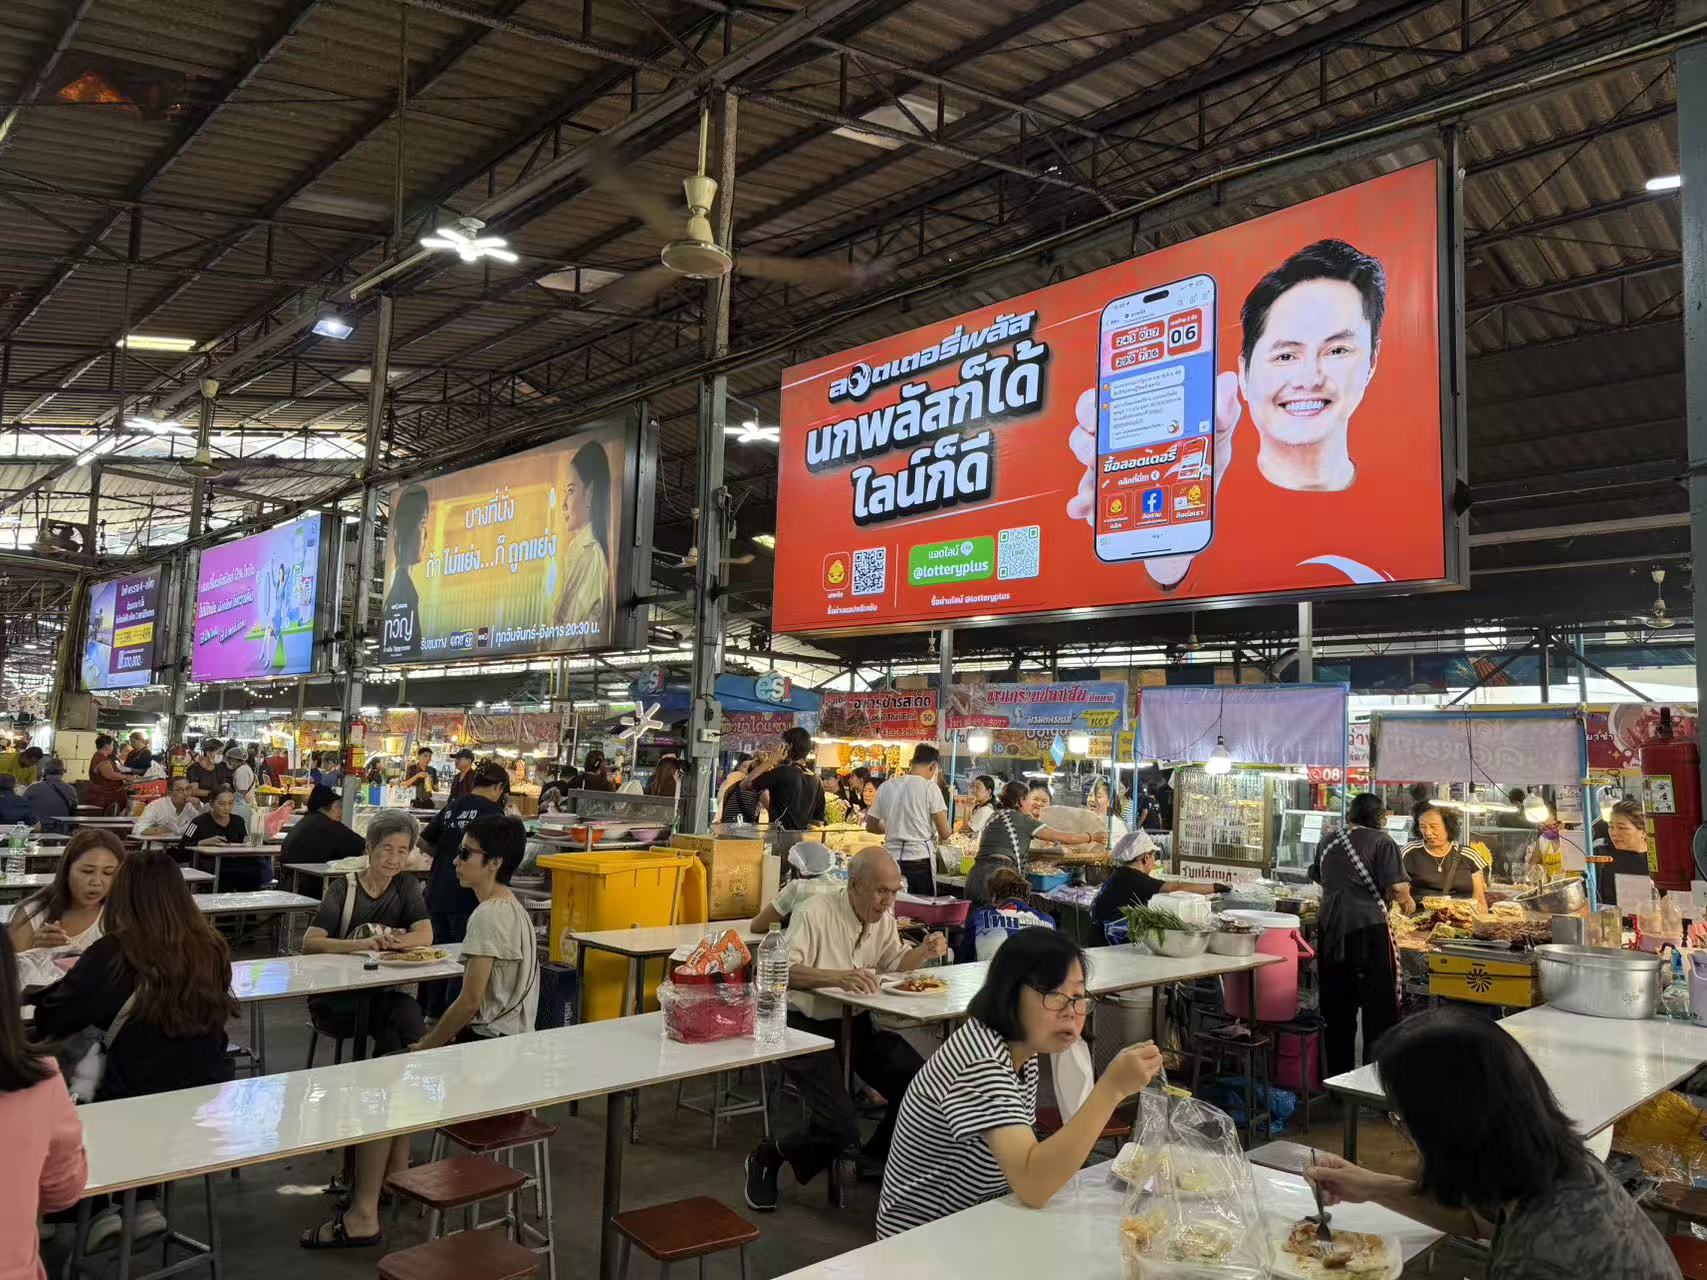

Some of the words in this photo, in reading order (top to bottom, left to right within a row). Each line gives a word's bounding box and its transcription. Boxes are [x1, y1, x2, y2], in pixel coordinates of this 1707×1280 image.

[1116, 334, 1136, 346] 243
[1139, 328, 1160, 340] 017
[1170, 325, 1197, 344] 06
[1115, 355, 1136, 367] 299
[1138, 349, 1159, 361] 736
[807, 339, 1045, 466] นกพลัสก็ได้
[851, 431, 991, 519] ไลน์ก็ดี
[465, 485, 515, 529] บางที่นั่ง
[1175, 510, 1204, 519] ติดต่อเรา
[508, 527, 557, 573] ถูกแย่ง
[913, 559, 989, 581] @lotteryplus
[964, 592, 1011, 603] @lotteryplus
[495, 623, 565, 648] ทุกวันจันทร์-อังคาร
[566, 621, 589, 634] 20:30
[591, 621, 601, 634] น.
[923, 713, 932, 721] 50
